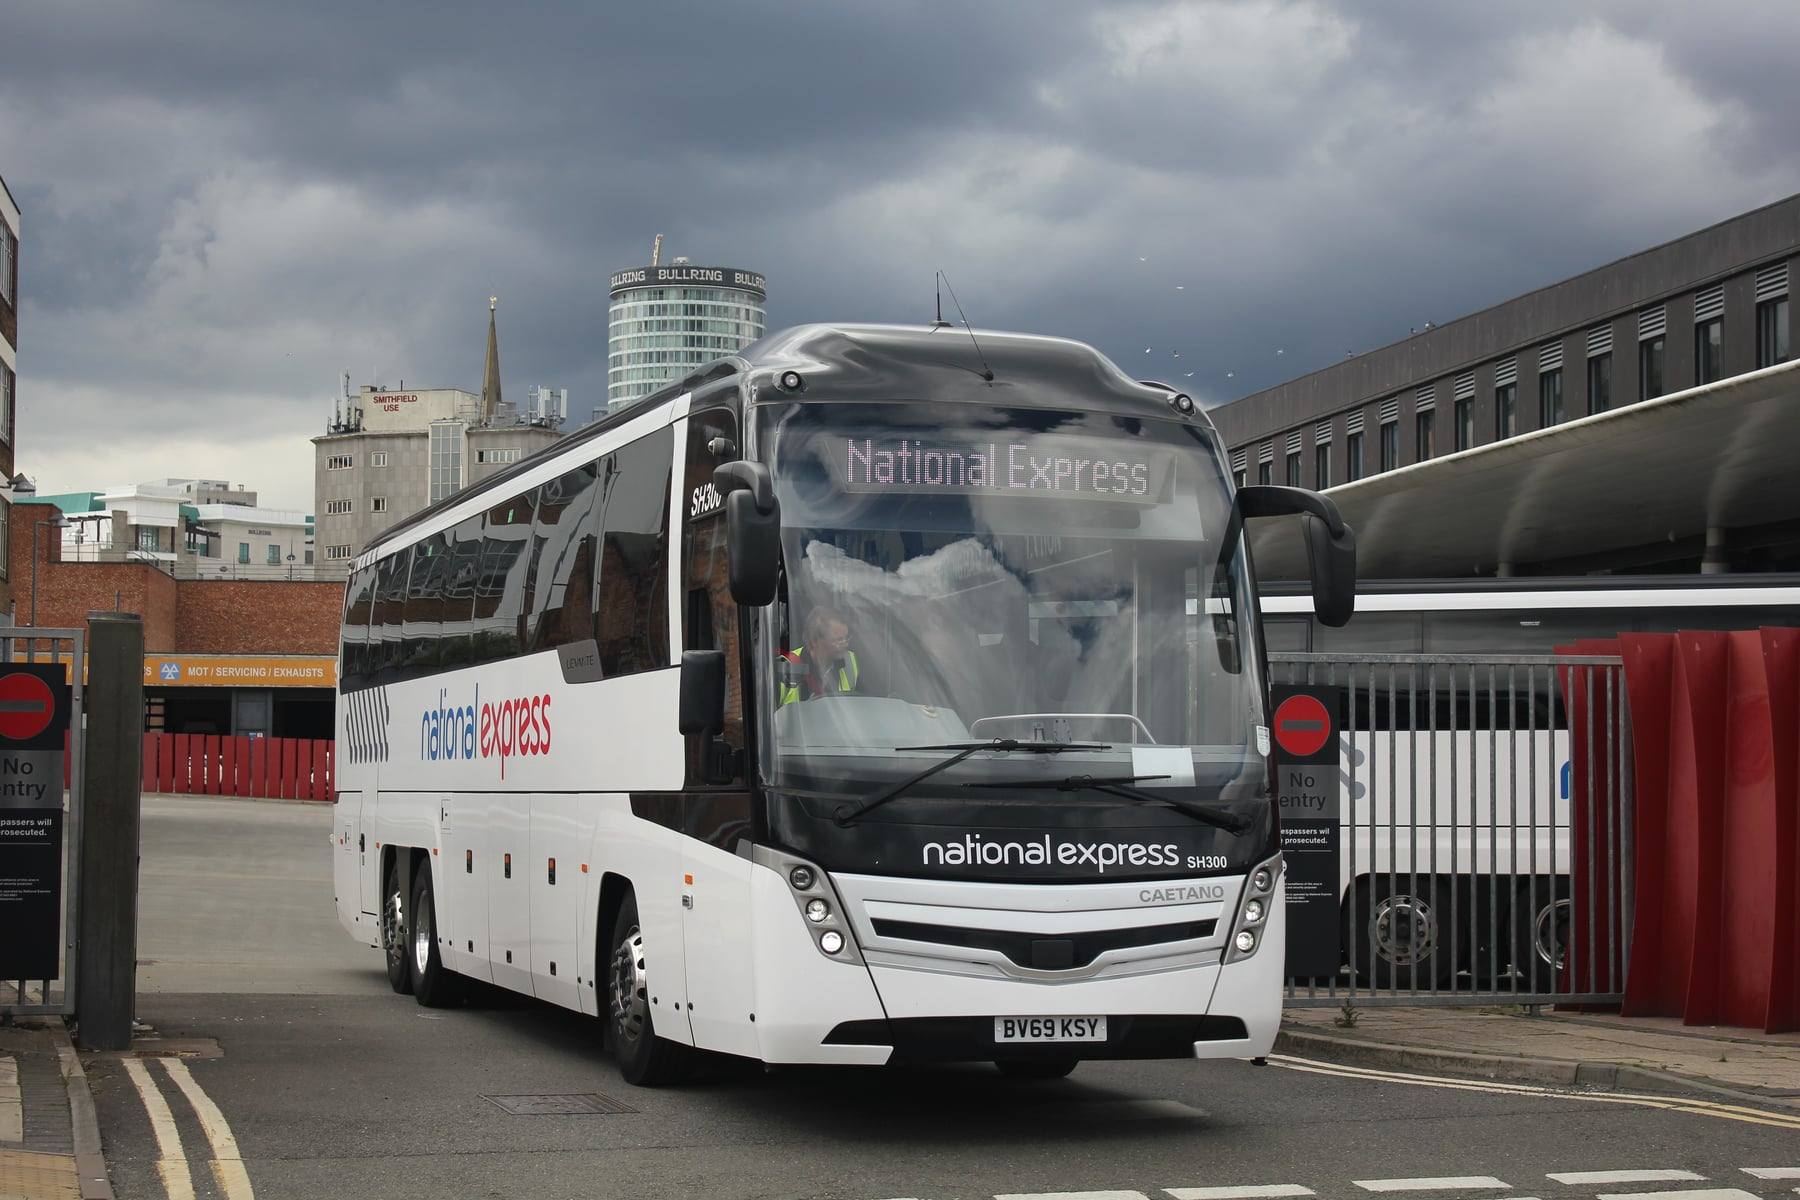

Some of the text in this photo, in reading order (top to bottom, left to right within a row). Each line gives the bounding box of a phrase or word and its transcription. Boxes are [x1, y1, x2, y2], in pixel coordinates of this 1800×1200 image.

[658, 269, 723, 281] BULLRING
[373, 395, 418, 404] SMITHFIELD
[383, 404, 400, 412] USE
[847, 438, 1148, 495] National Express
[188, 667, 209, 677] MOT
[215, 667, 267, 678] SERVICING
[273, 668, 324, 678] EXHAUSTS
[421, 682, 551, 781] national express
[3, 757, 34, 775] No
[1290, 772, 1315, 788] No
[1280, 793, 1327, 811] entry
[37, 818, 52, 826] will
[1284, 836, 1328, 846] prosecuted.
[922, 833, 1227, 874] national express SH300
[1138, 885, 1225, 903] CAETANO
[1003, 1018, 1098, 1038] BV69 KSY
